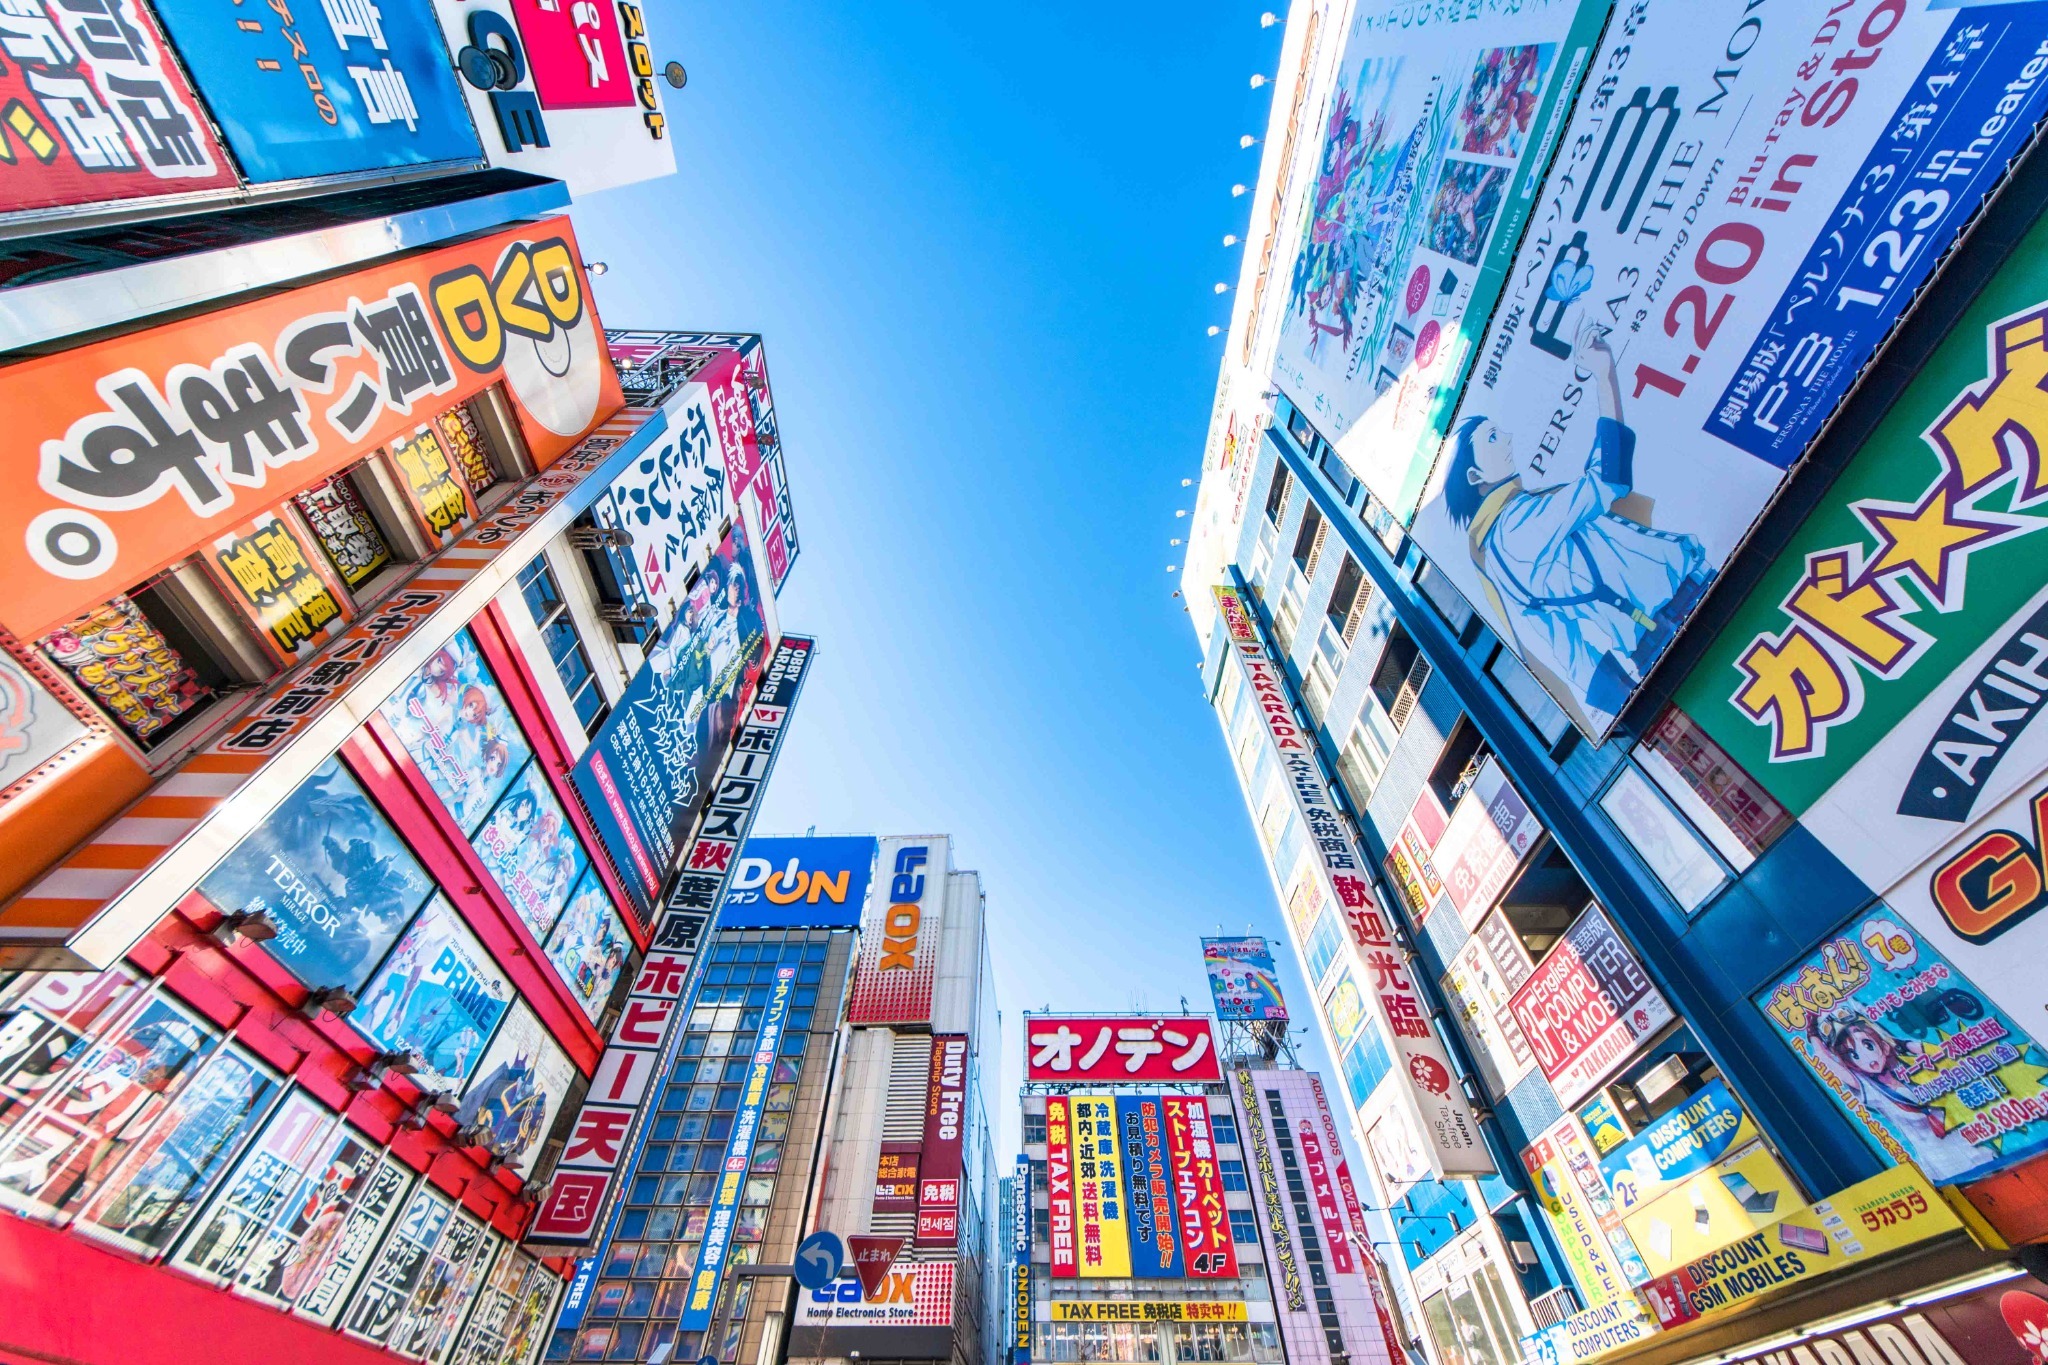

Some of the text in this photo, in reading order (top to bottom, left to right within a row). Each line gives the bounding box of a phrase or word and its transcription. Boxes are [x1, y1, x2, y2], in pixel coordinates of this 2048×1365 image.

[617, 1, 668, 141] スロット
[1727, 88, 1806, 209] Blu-ray
[1634, 139, 1705, 247] THE
[1496, 207, 1523, 258] Twitter
[1645, 223, 1692, 304] Falling
[1683, 156, 1725, 223] Down
[1837, 187, 1950, 313] 1.23
[1916, 150, 1956, 182] in
[1632, 221, 1765, 402] 1.20
[1751, 153, 1819, 215] in
[1771, 328, 1858, 450] PERSONA3 THE MOVIE
[218, 534, 314, 660] 査定
[254, 518, 342, 635] 高額
[124, 620, 181, 677] アダルト
[228, 592, 431, 753] アキバ駅前店
[759, 639, 793, 703] PARADISE
[782, 640, 810, 684] HOBBY
[1246, 662, 1304, 749] TAKARADA
[1305, 807, 1356, 871] 免税商店
[263, 852, 342, 939] TERROR
[1479, 846, 1522, 900] TAKARADA
[279, 894, 309, 925] MIRAGE
[1533, 917, 1608, 999] English 英語版
[1866, 930, 1911, 962] 7巻
[429, 945, 502, 1033] PRIME
[1543, 936, 1630, 1027] COMPUTER
[1555, 1027, 1582, 1054] &
[1571, 963, 1647, 1041] MOBILE
[1866, 962, 1949, 1022] おりもとみまな
[1031, 1020, 1211, 1073] オノデン
[1521, 996, 1559, 1068] 3F
[1576, 1019, 1640, 1080] TAKARADA
[929, 1041, 945, 1117] Flagship Store
[939, 1040, 966, 1141] Duty Free
[1310, 1077, 1343, 1157] ADULT GOODS
[1433, 1119, 1451, 1150] Shop
[1648, 1093, 1719, 1150] DISCOUNT
[1653, 1108, 1738, 1172] COMPUTERS
[726, 1157, 747, 1171] 4F
[1048, 1101, 1073, 1266] 免税 TAX FREE
[1095, 1103, 1119, 1220] 冷蔵庫 洗濯機
[1125, 1112, 1152, 1242] お見積り無料です
[1525, 1143, 1554, 1171] 2F
[401, 1193, 450, 1246] 2F
[923, 1184, 955, 1202] 免税
[1016, 1162, 1030, 1251] Panasonic
[1304, 1141, 1347, 1269] ラブメルシー
[1339, 1175, 1356, 1210] LOVE
[1614, 1176, 1643, 1208] 2F
[1860, 1189, 1930, 1233] タカラダ
[691, 1172, 742, 1312] 調理・理美容・健康
[856, 1247, 893, 1264] 止まれ
[920, 1217, 955, 1232] 면세점
[1194, 1254, 1226, 1273] 4F
[1687, 1232, 1773, 1286] DISCOUNT
[1690, 1251, 1807, 1314] GSM MOBILES
[567, 1274, 590, 1310] FREE
[807, 1307, 914, 1319] Home Electronics Store
[1017, 1265, 1029, 1348] ONODEN
[1060, 1303, 1093, 1320] TAX
[1096, 1303, 1141, 1319] FREE
[1143, 1303, 1182, 1319] 免税店
[1565, 1300, 1625, 1338] DISCOUNT
[1570, 1319, 1642, 1359] COMPUTERS
